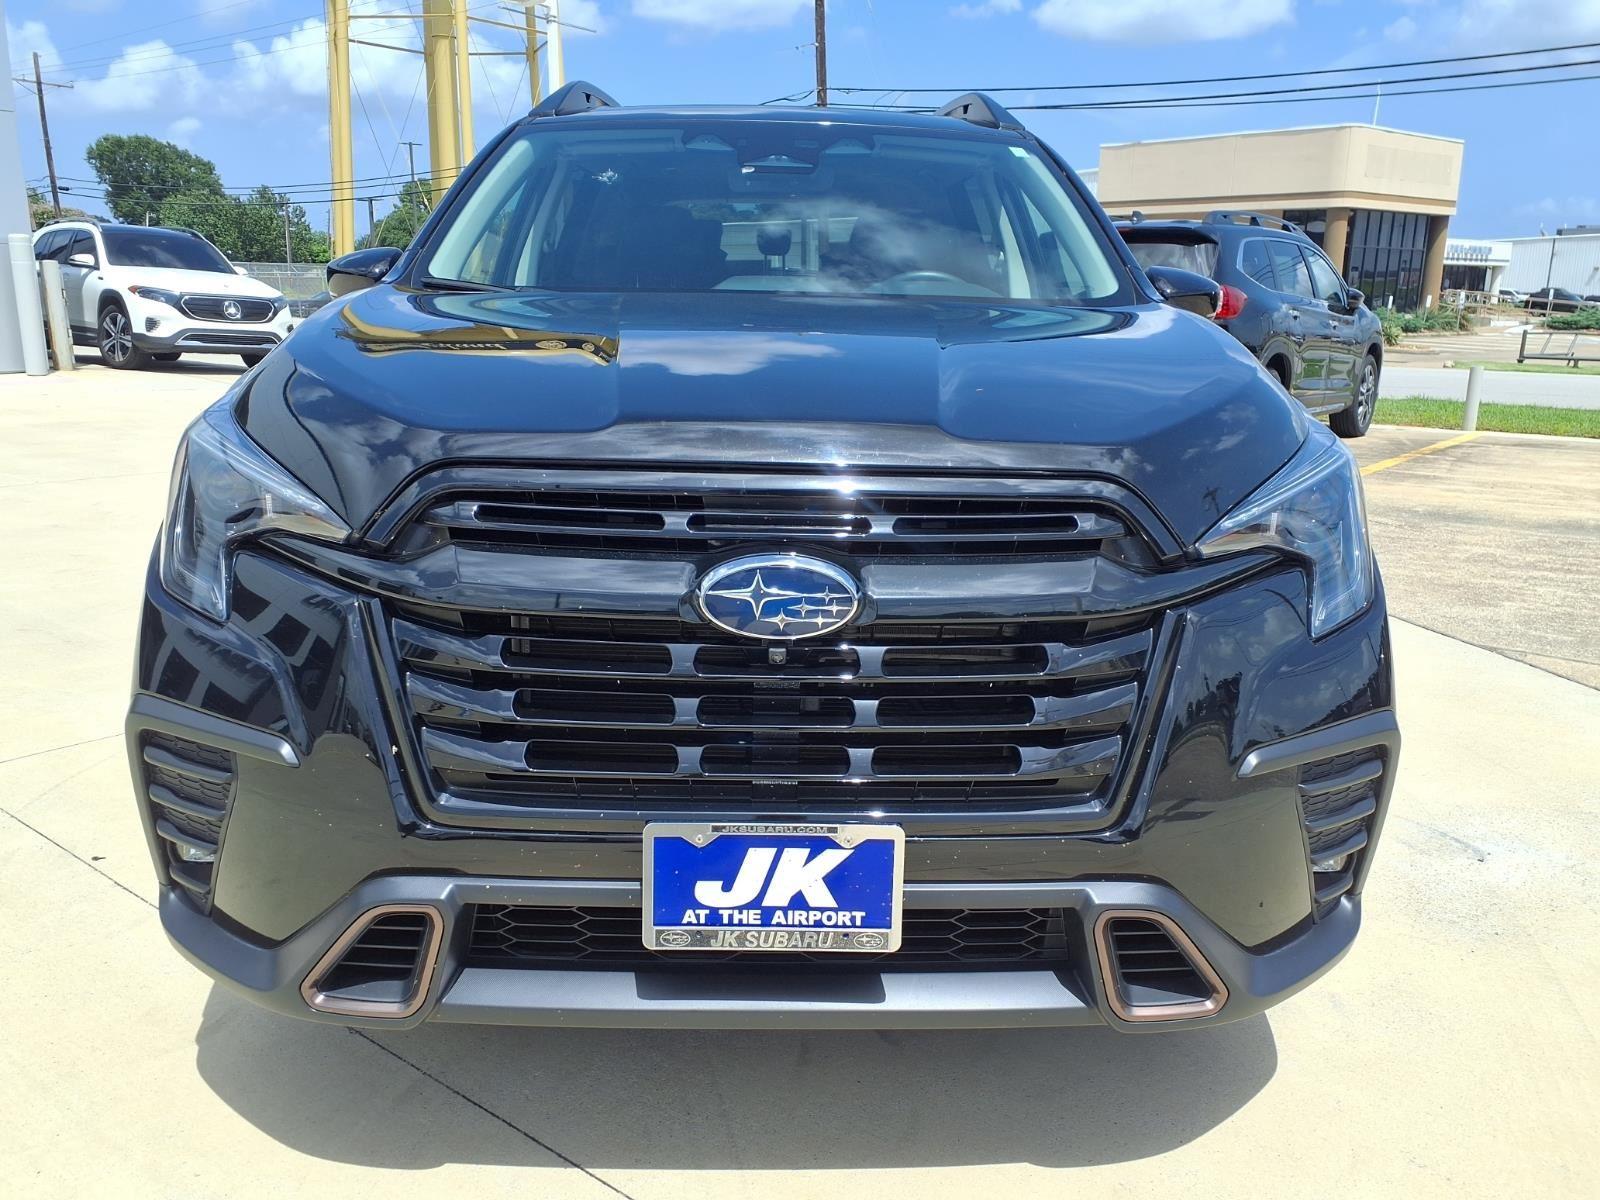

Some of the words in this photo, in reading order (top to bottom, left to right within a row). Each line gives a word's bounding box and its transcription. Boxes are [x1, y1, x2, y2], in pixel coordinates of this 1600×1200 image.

[722, 825, 828, 834] JKSUBARU.COM
[694, 847, 855, 908] JK
[681, 909, 709, 925] AT
[719, 909, 761, 925] THE
[770, 910, 866, 926] AIRPORT
[710, 930, 739, 948] JK
[744, 930, 835, 949] SUBARU
